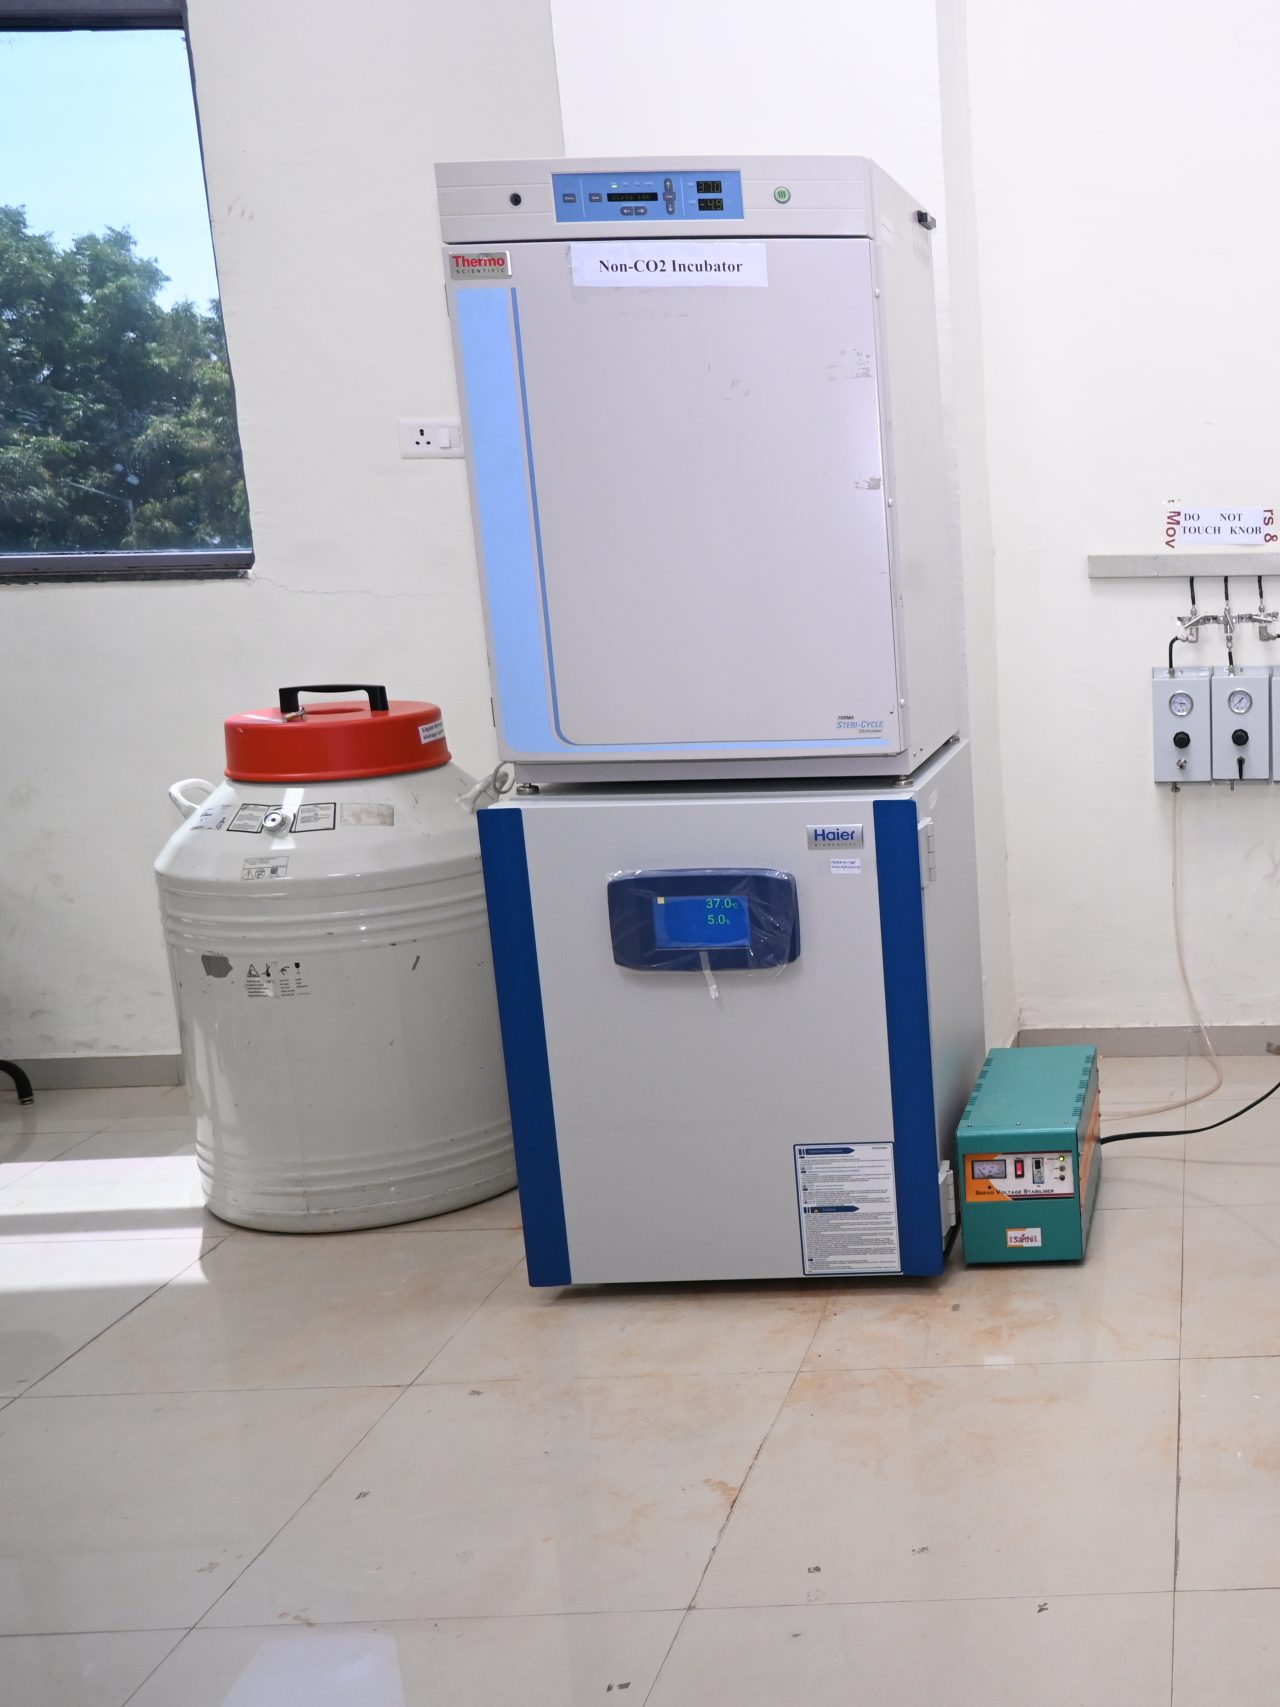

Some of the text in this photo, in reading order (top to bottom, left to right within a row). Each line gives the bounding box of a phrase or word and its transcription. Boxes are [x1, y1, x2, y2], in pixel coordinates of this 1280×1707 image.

[452, 255, 505, 268] Thermo
[599, 259, 743, 273] Non-CO2 Incubator
[1184, 512, 1243, 522] DO NOT
[1181, 525, 1262, 535] TOUCH KNOB
[814, 828, 856, 841] Haier
